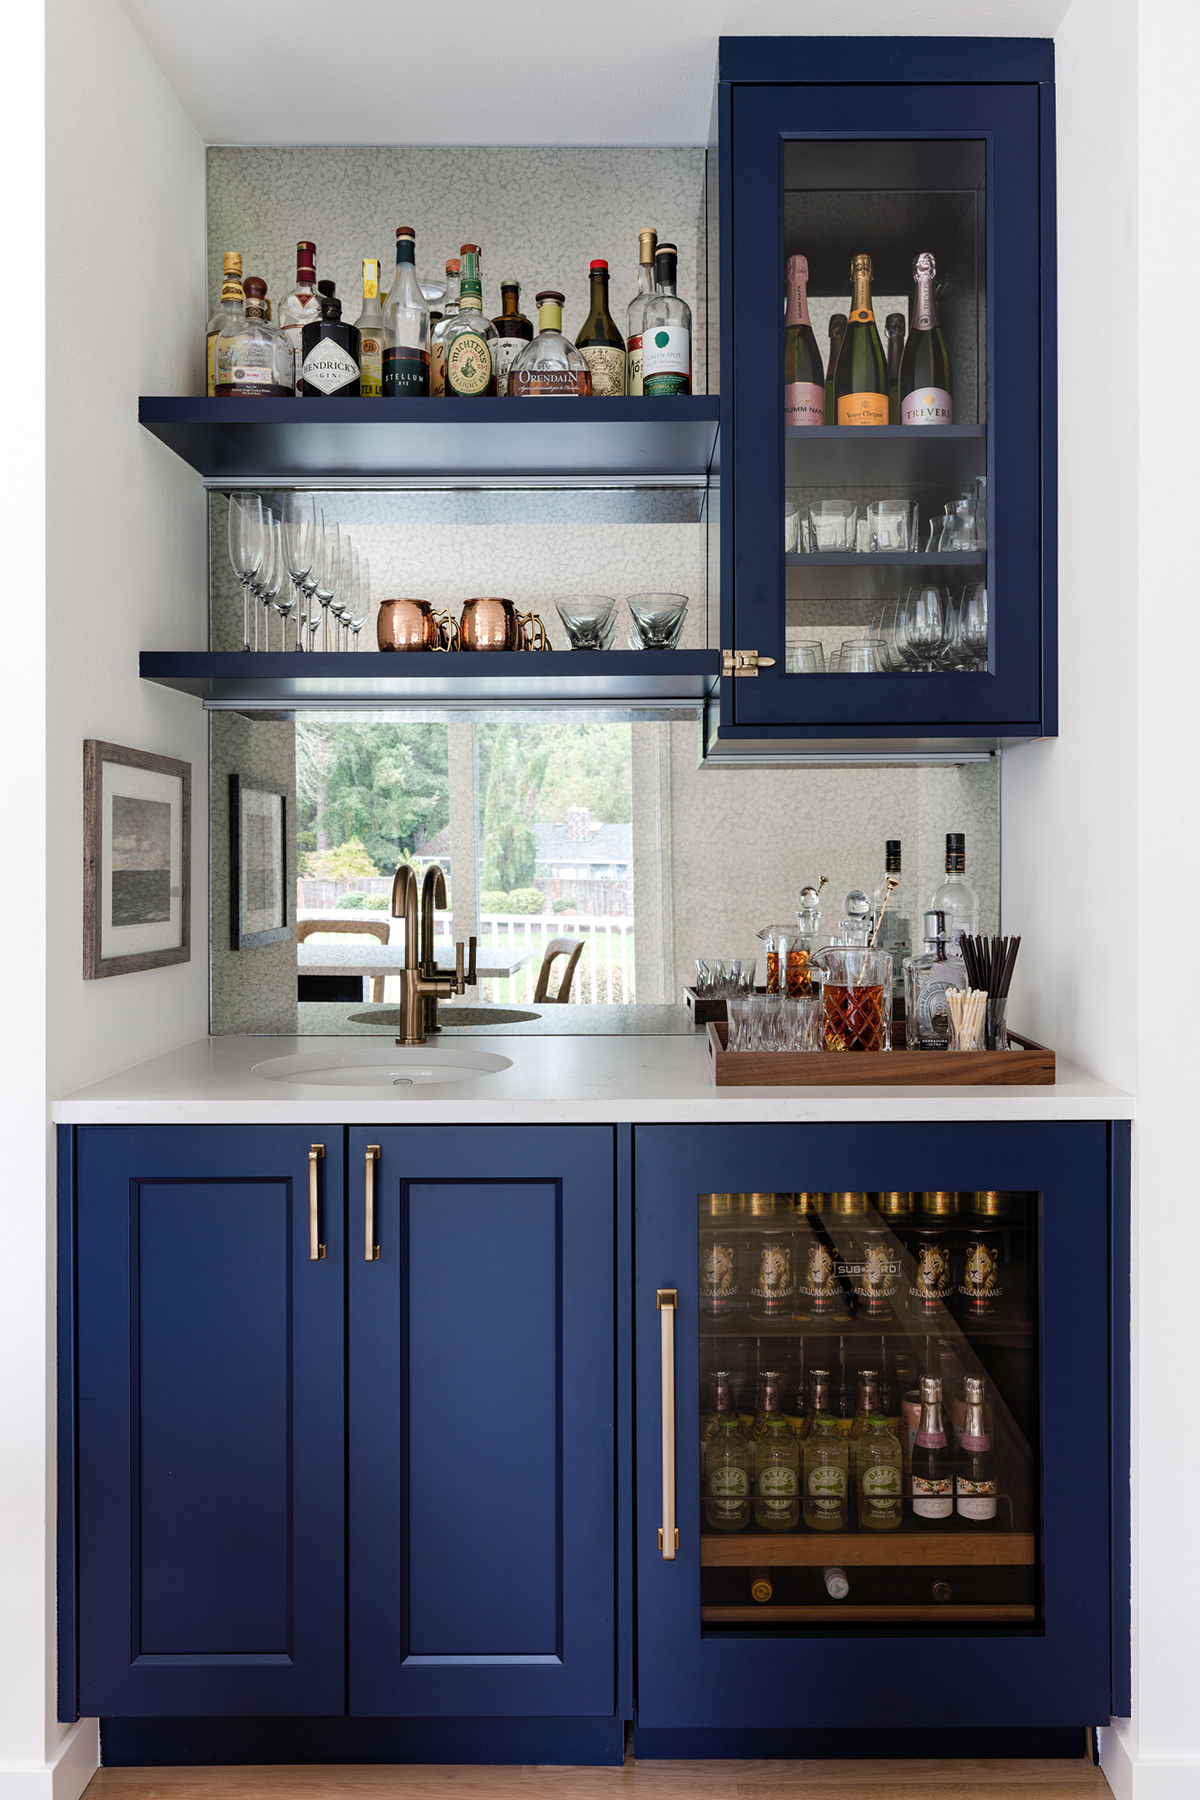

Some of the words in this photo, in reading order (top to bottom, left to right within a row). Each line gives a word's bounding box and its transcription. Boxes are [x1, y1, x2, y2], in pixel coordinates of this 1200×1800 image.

[452, 340, 486, 363] MICHTER'S
[304, 362, 357, 374] HENDRICK'S
[385, 373, 424, 383] STELLUM
[452, 371, 478, 389] STRAIGHT
[478, 371, 487, 383] RYE
[519, 370, 577, 384] ORENDAIN
[361, 385, 372, 395] TER
[906, 408, 950, 420] TREVERI
[700, 1288, 719, 1298] RICAN
[751, 1287, 778, 1298] AFRICAN
[799, 1286, 824, 1297] AFRICAN
[854, 1286, 881, 1298] AFRICAN
[909, 1287, 936, 1298] AFRICAN
[958, 1285, 983, 1297] AFRICAN
[714, 1470, 744, 1481] BETTY
[764, 1470, 793, 1481] BETTY
[814, 1470, 842, 1481] BETTY
[868, 1469, 896, 1480] BETTY
